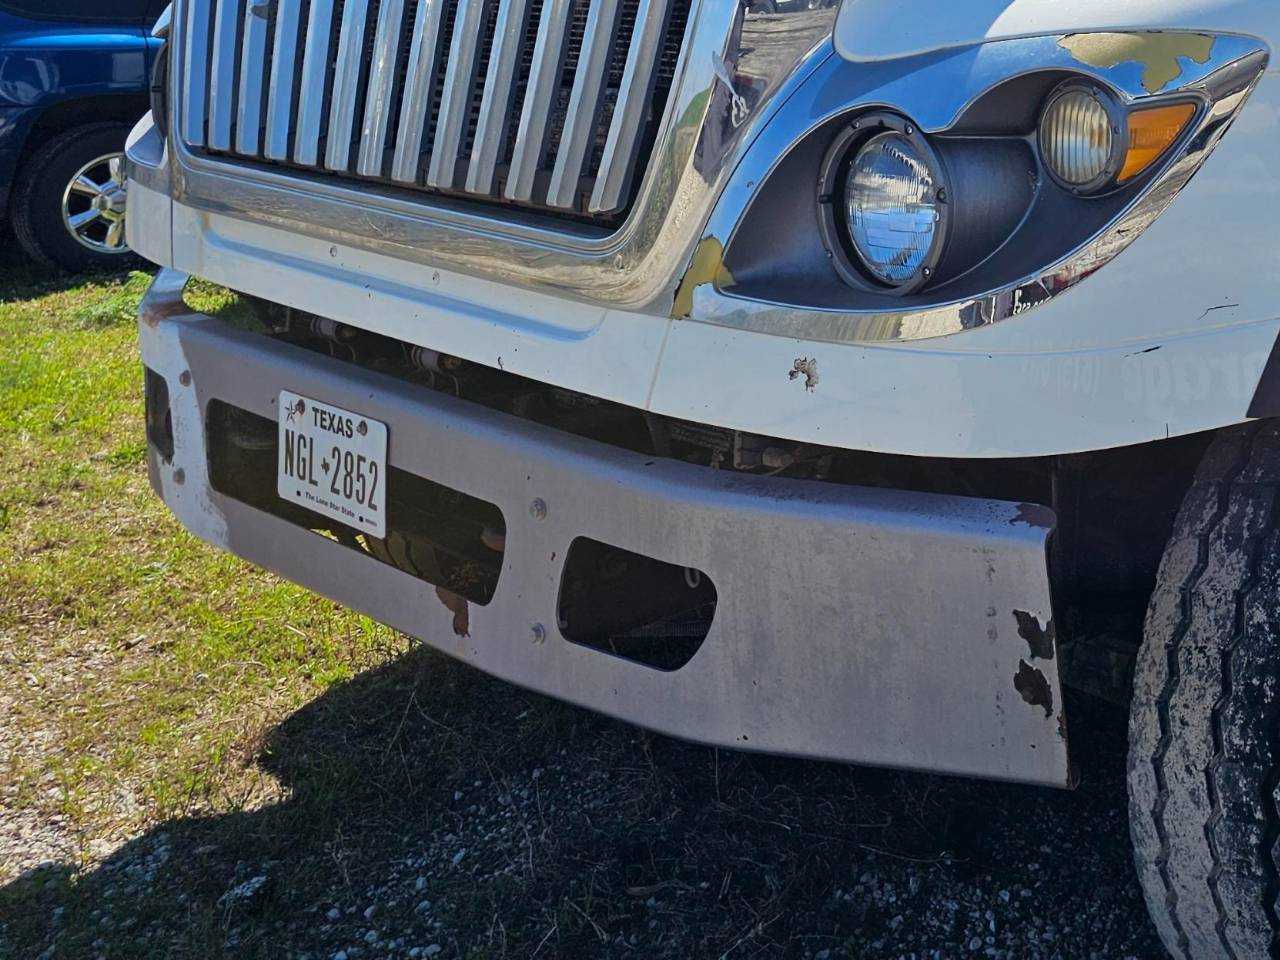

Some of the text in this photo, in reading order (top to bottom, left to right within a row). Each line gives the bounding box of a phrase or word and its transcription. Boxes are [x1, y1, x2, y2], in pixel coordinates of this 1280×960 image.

[311, 406, 354, 439] TEXAS
[284, 429, 378, 512] NGL 2852
